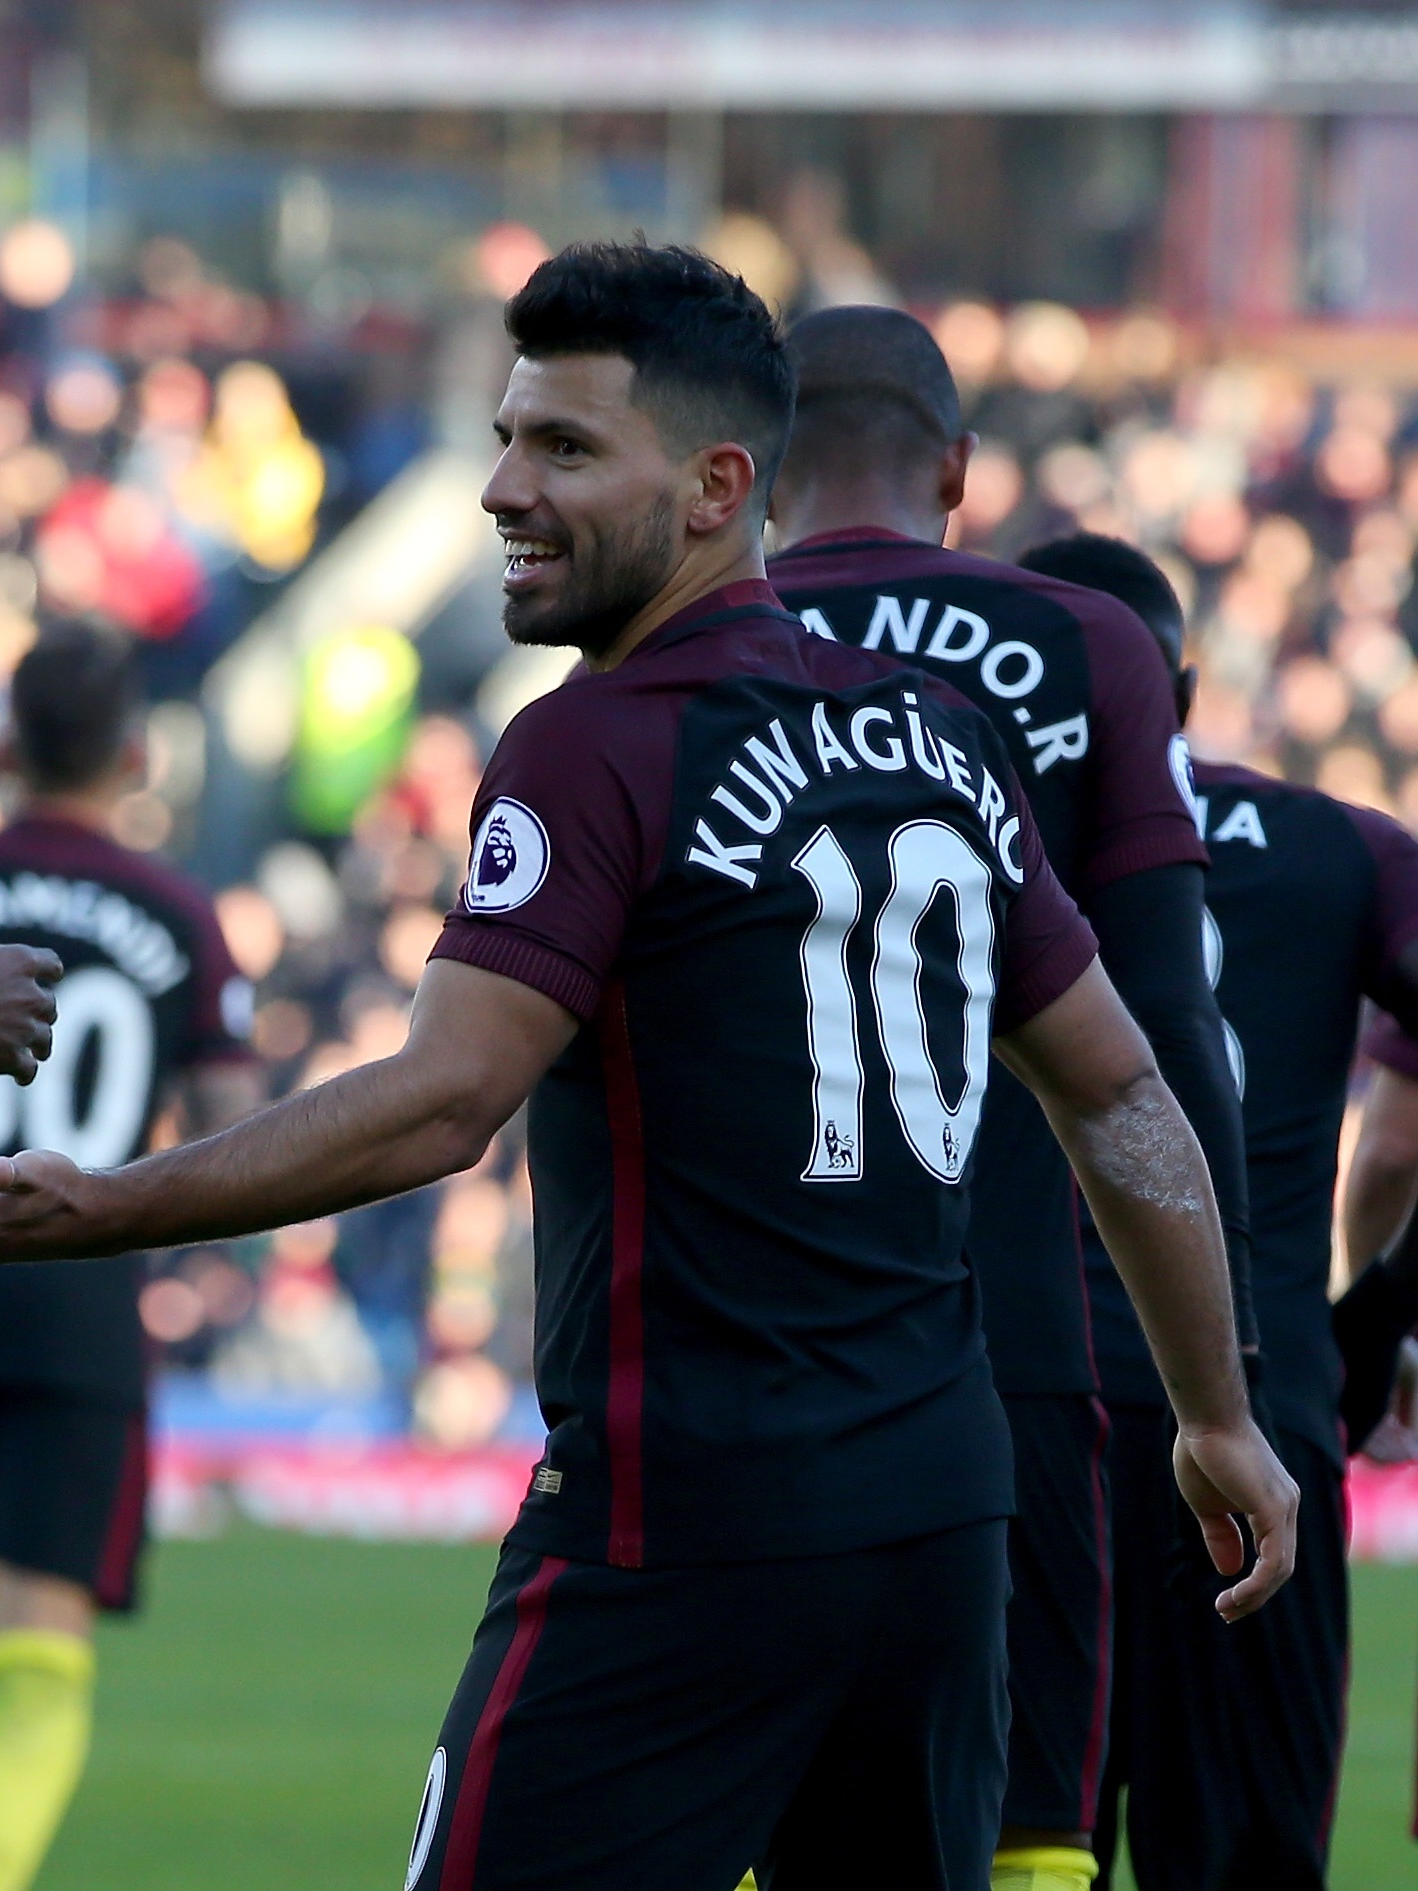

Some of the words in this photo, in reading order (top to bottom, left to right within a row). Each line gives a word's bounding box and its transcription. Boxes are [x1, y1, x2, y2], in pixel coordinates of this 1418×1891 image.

[800, 594, 1090, 775] ANDO.R
[686, 718, 810, 890] KUN
[790, 817, 997, 1184] 10
